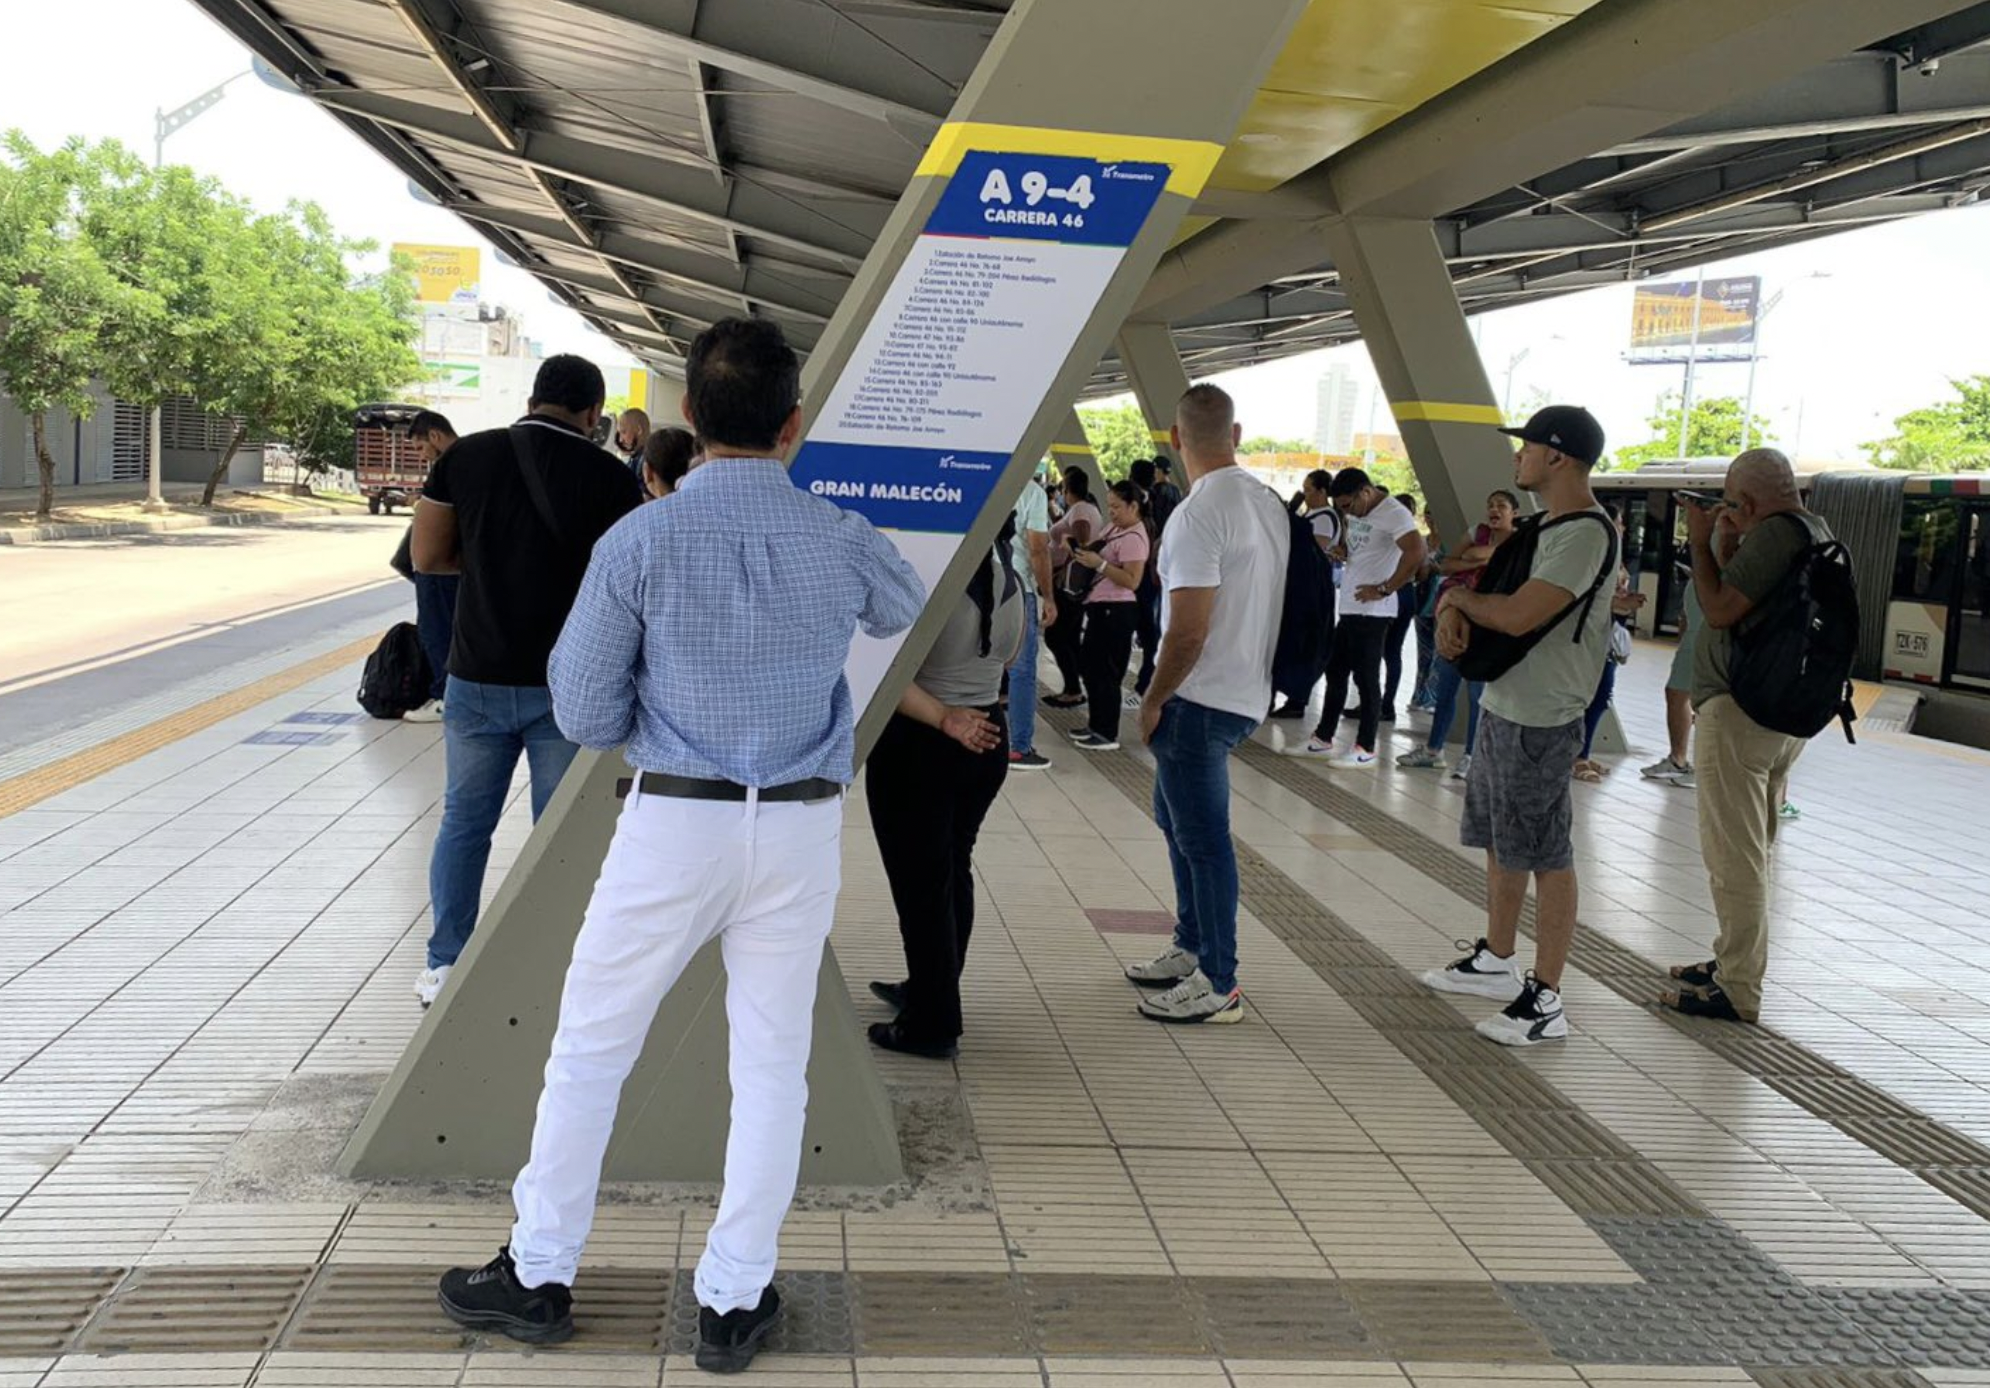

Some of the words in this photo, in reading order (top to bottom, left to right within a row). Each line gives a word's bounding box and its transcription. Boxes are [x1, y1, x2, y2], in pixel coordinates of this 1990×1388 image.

[979, 168, 1012, 204] A
[1021, 171, 1096, 209] 9-4
[984, 208, 1058, 227] CARRERA
[1062, 213, 1084, 228] 46
[810, 480, 865, 498] GRAN
[870, 483, 962, 503] MALECÓN
